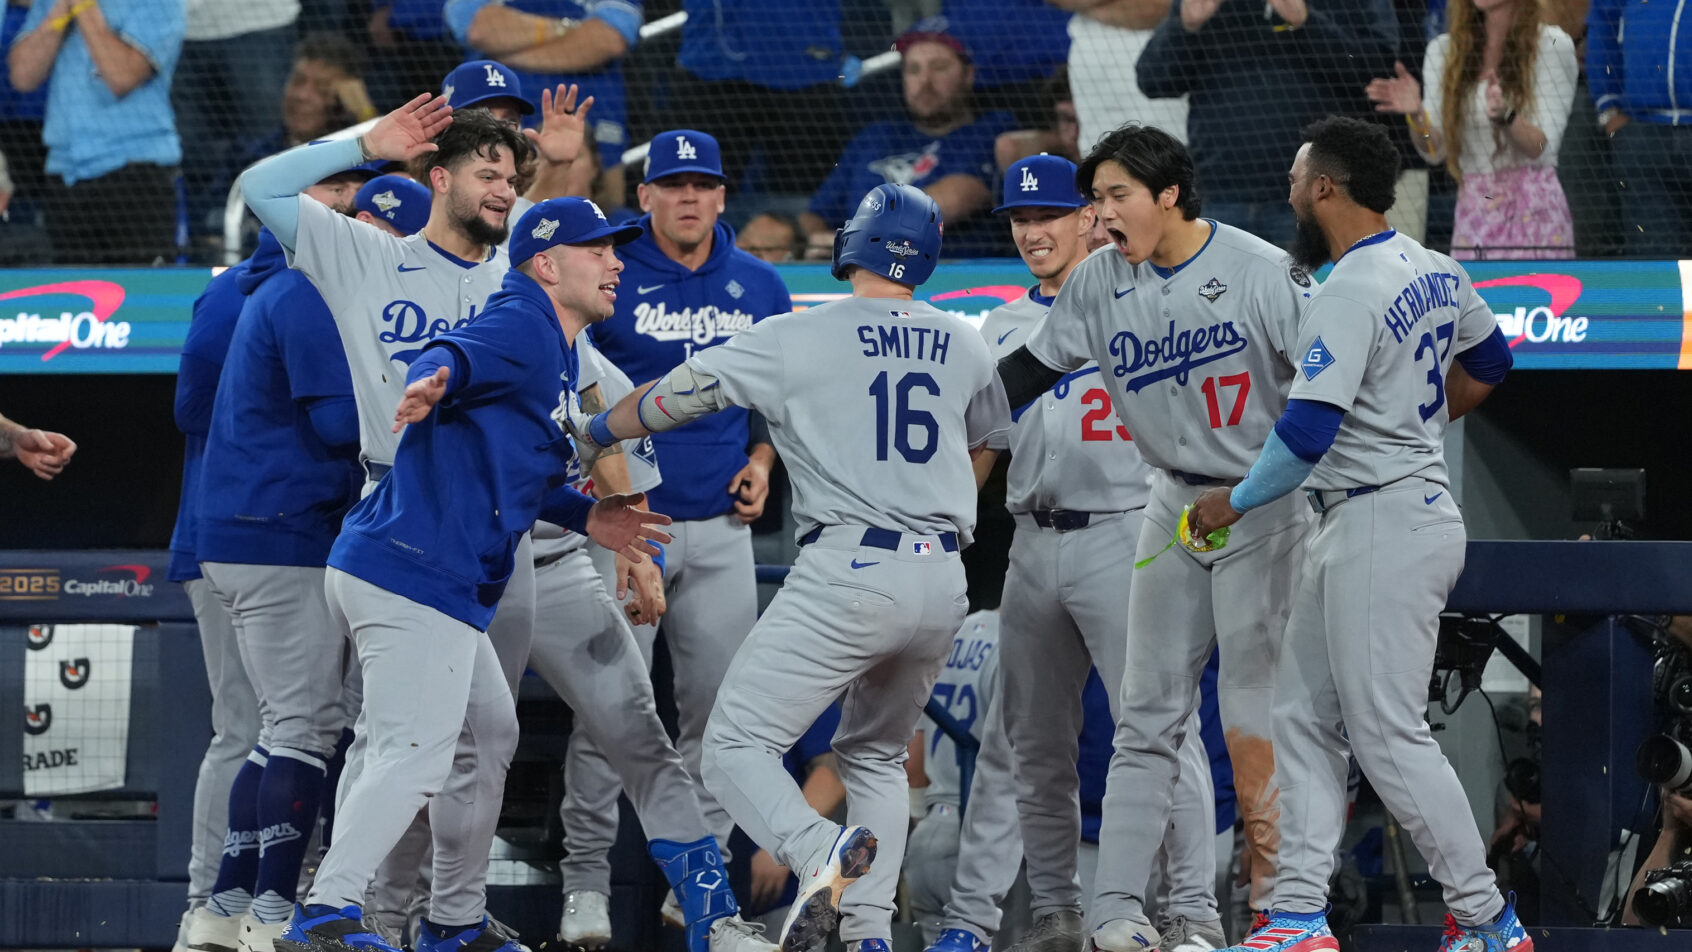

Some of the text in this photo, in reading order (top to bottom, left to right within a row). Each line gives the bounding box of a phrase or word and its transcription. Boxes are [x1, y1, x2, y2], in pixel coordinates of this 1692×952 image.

[484, 64, 506, 87] LA
[676, 136, 697, 159] LA
[1020, 167, 1039, 191] LA
[888, 262, 906, 279] 16
[857, 325, 951, 365] SMITH
[1109, 320, 1248, 388] Dodgers
[1414, 320, 1454, 424] 37
[868, 371, 941, 464] 16
[1201, 371, 1251, 429] 17
[0, 576, 60, 593] 2025
[946, 638, 992, 671] OJAS
[931, 682, 978, 766] 72
